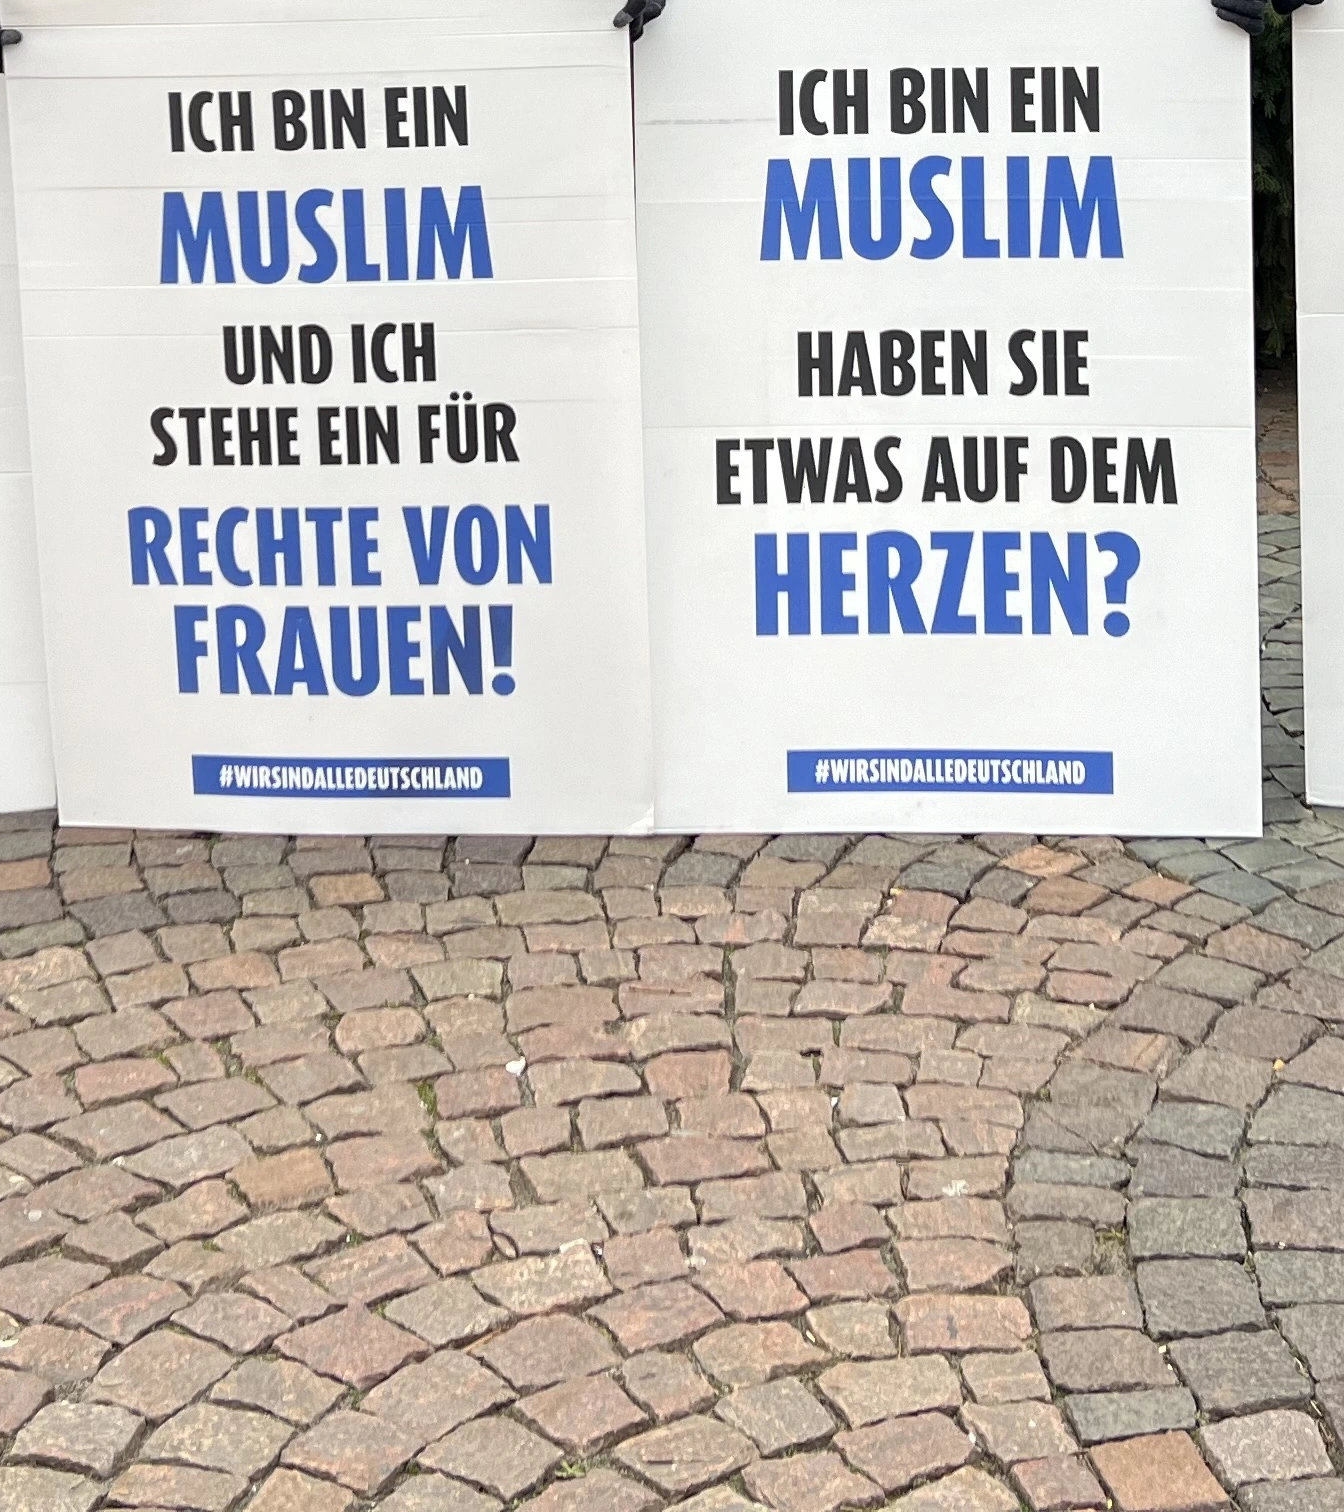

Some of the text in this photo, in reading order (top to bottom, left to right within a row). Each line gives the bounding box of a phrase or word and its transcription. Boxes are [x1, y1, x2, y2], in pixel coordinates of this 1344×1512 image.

[169, 85, 468, 152] ICH BIN EIN
[779, 67, 1099, 135] ICH BIN EIN
[161, 186, 493, 284] MUSLIM
[760, 156, 1123, 260] MUSLIM
[223, 323, 436, 385] UND ICH
[798, 330, 1089, 397] HABEN SIE
[151, 392, 519, 466] STEHE EIN FÜR
[716, 437, 1177, 504] ETWAS AUF DEM
[128, 505, 552, 586] RECHTE VON
[755, 531, 1140, 637] HERZEN?
[175, 605, 515, 696] FRAUEN!
[220, 765, 482, 789] #WIRSINDALLEDEUTSCHLAND
[815, 759, 1085, 784] #WIRSINDALLEDEUTSCHLAND
